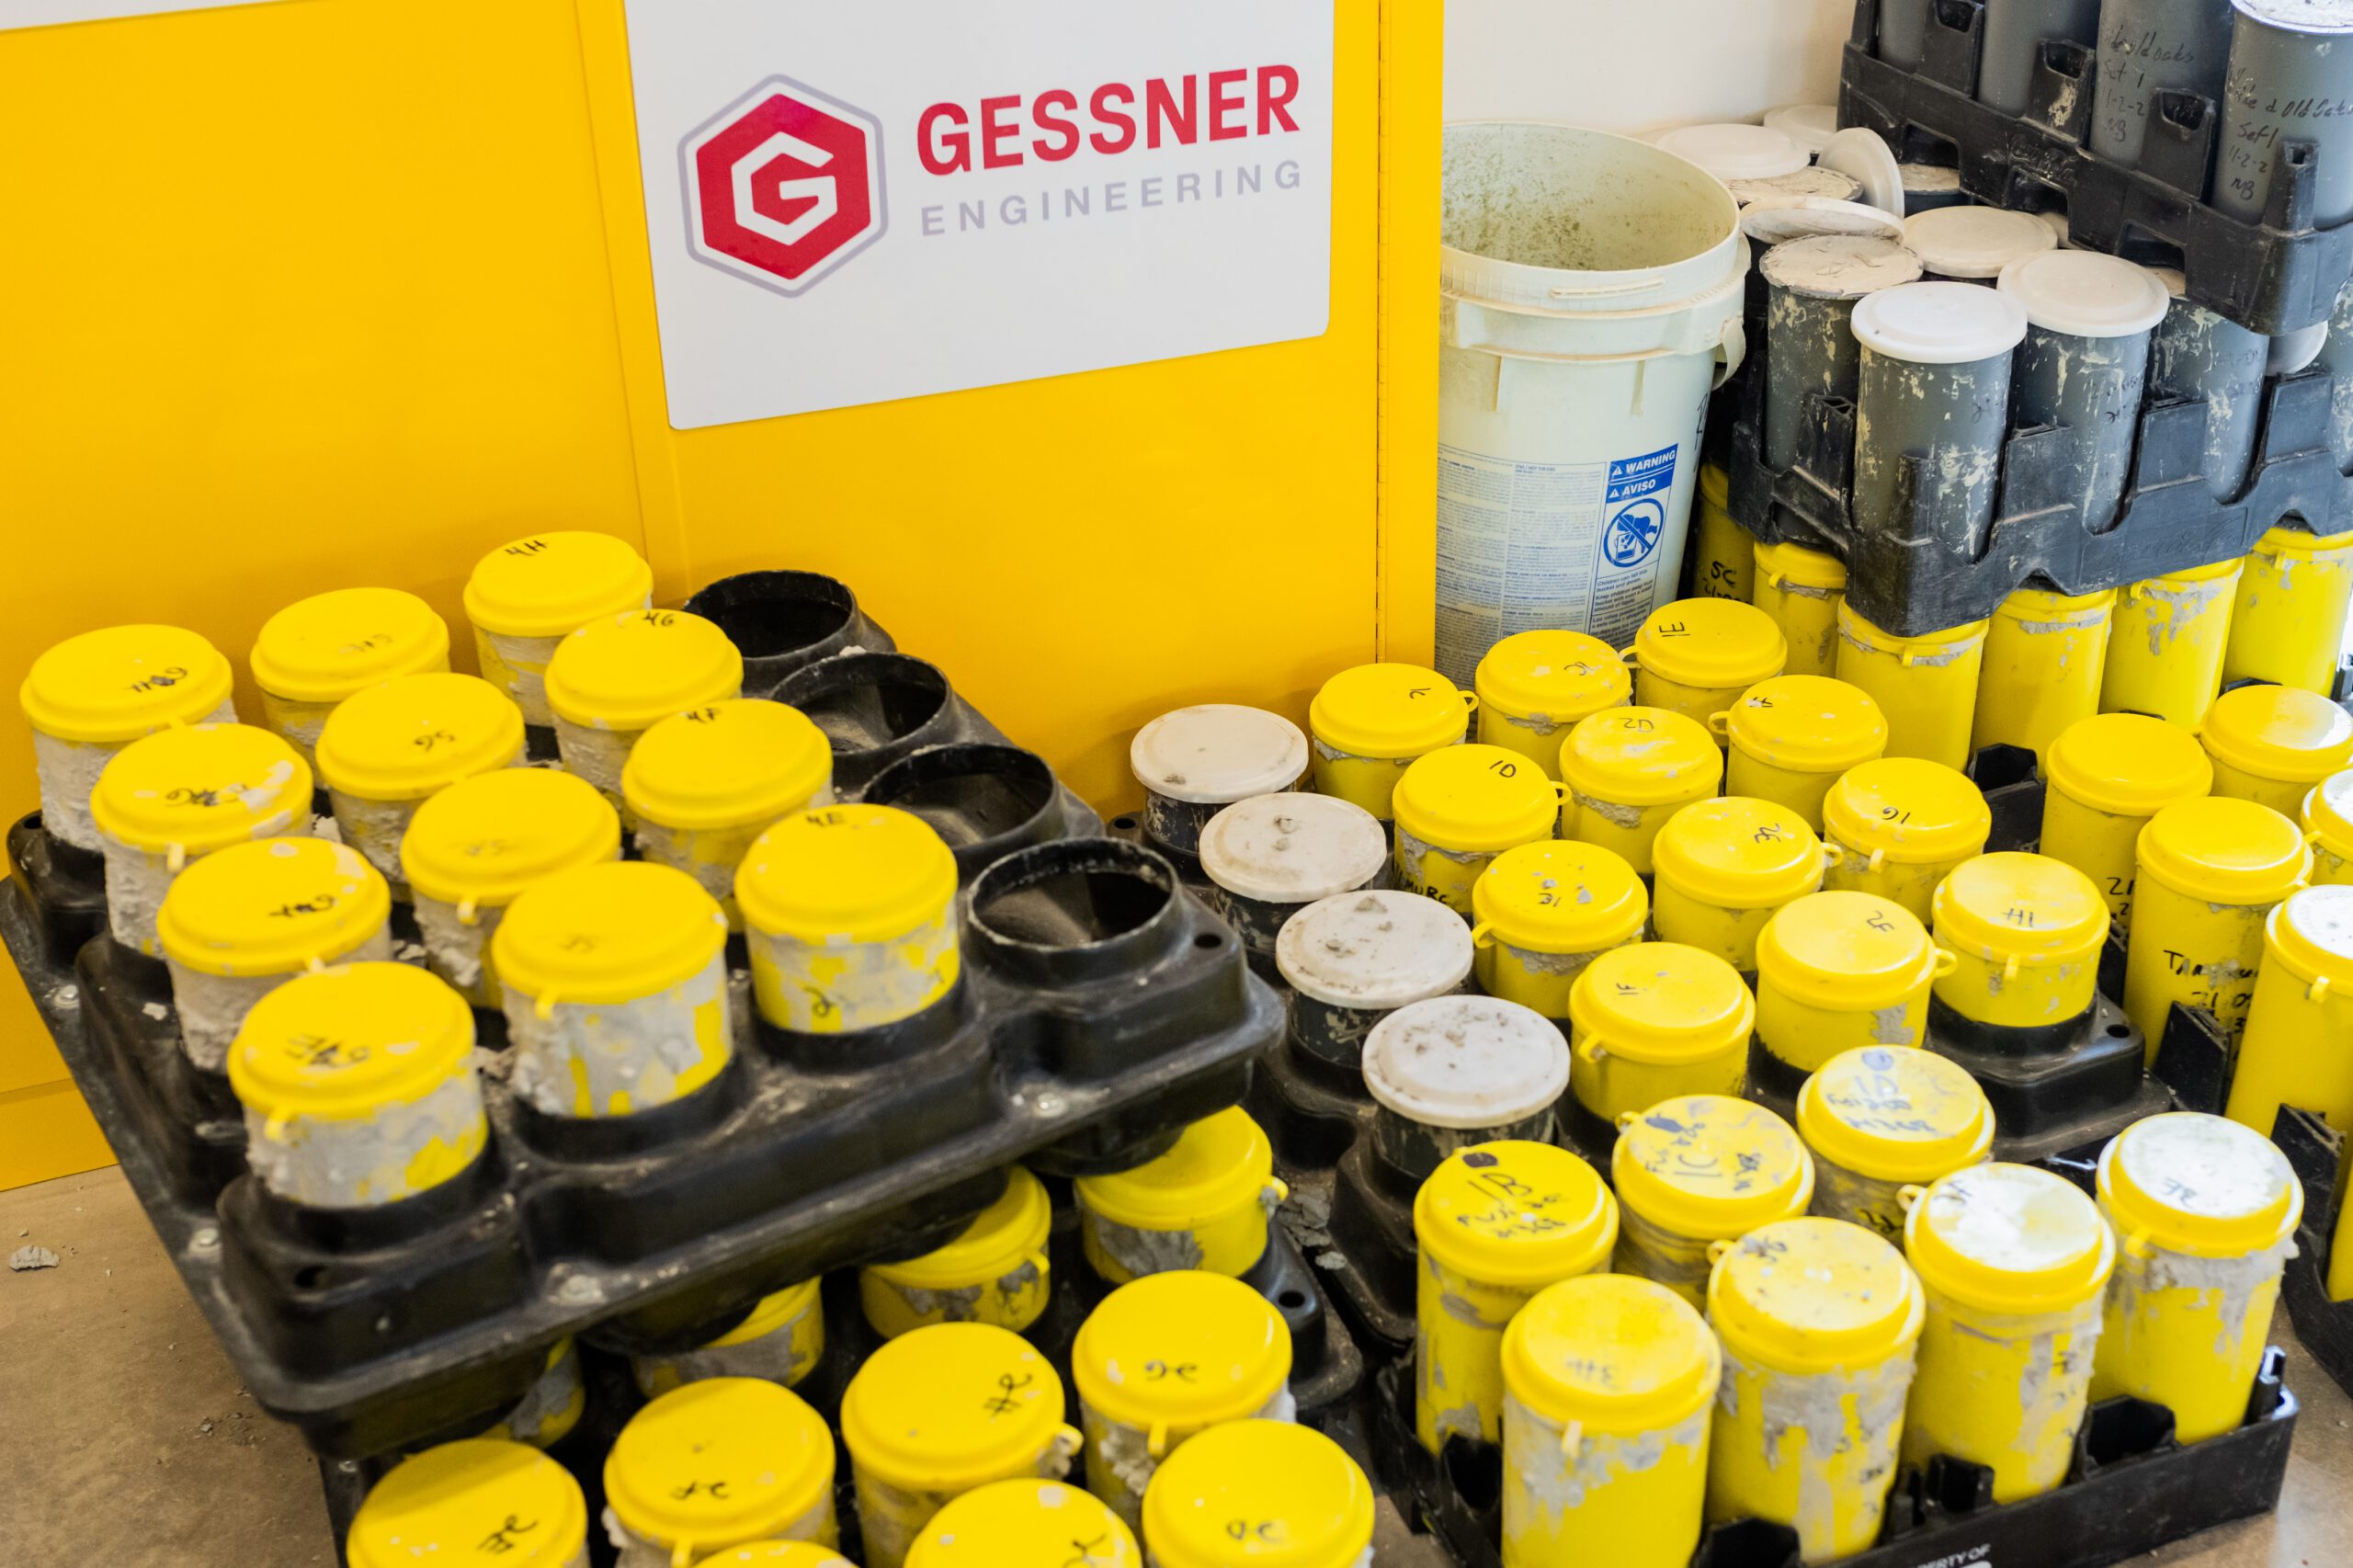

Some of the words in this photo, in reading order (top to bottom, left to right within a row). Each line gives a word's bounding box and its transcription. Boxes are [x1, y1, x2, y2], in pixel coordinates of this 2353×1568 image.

[916, 64, 1302, 176] GESSNER
[921, 160, 1302, 237] ENGINEERING
[1625, 449, 1676, 474] WARNING
[1621, 479, 1656, 496] AVISO
[1968, 1543, 1991, 1561] OF
